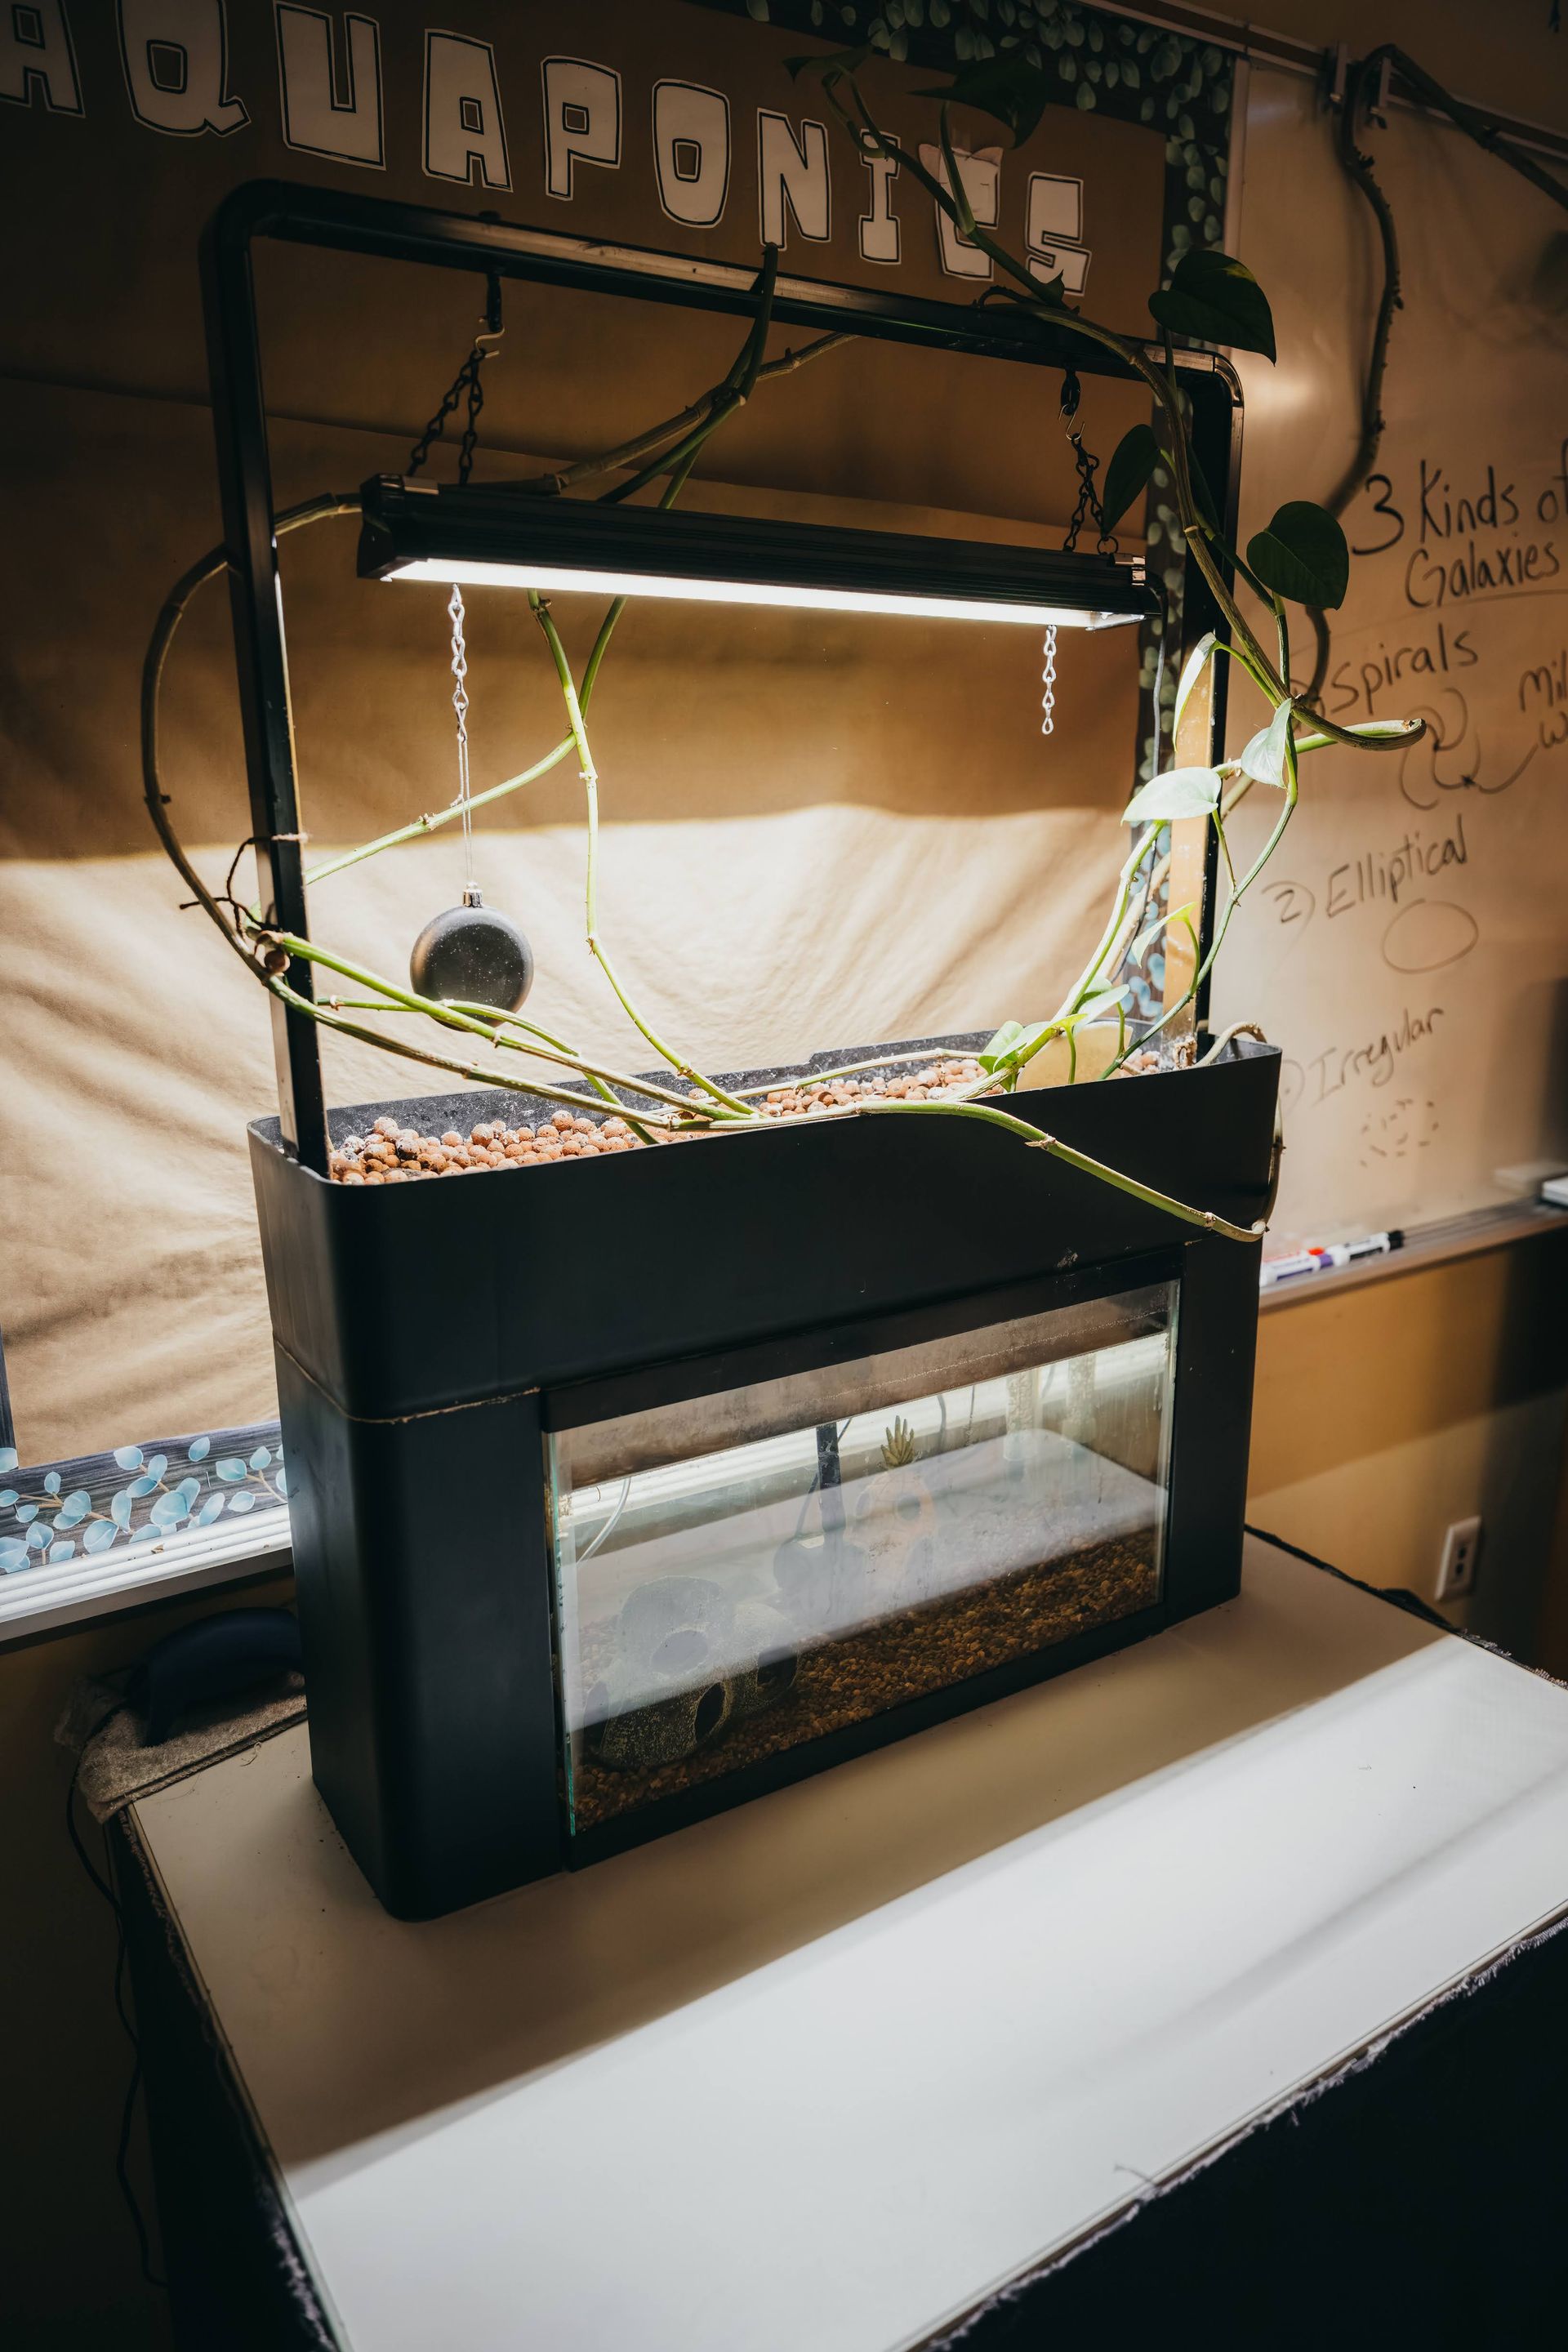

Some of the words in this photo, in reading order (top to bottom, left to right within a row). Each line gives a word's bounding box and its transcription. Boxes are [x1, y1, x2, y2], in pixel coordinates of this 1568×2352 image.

[0, 0, 1092, 296] AQUAPONICS
[1352, 473, 1405, 556] 3
[1419, 459, 1520, 544] Kinds
[1405, 539, 1560, 608] Galaxies
[1325, 813, 1468, 919] Elliptical
[1308, 1007, 1444, 1107] Irregular
